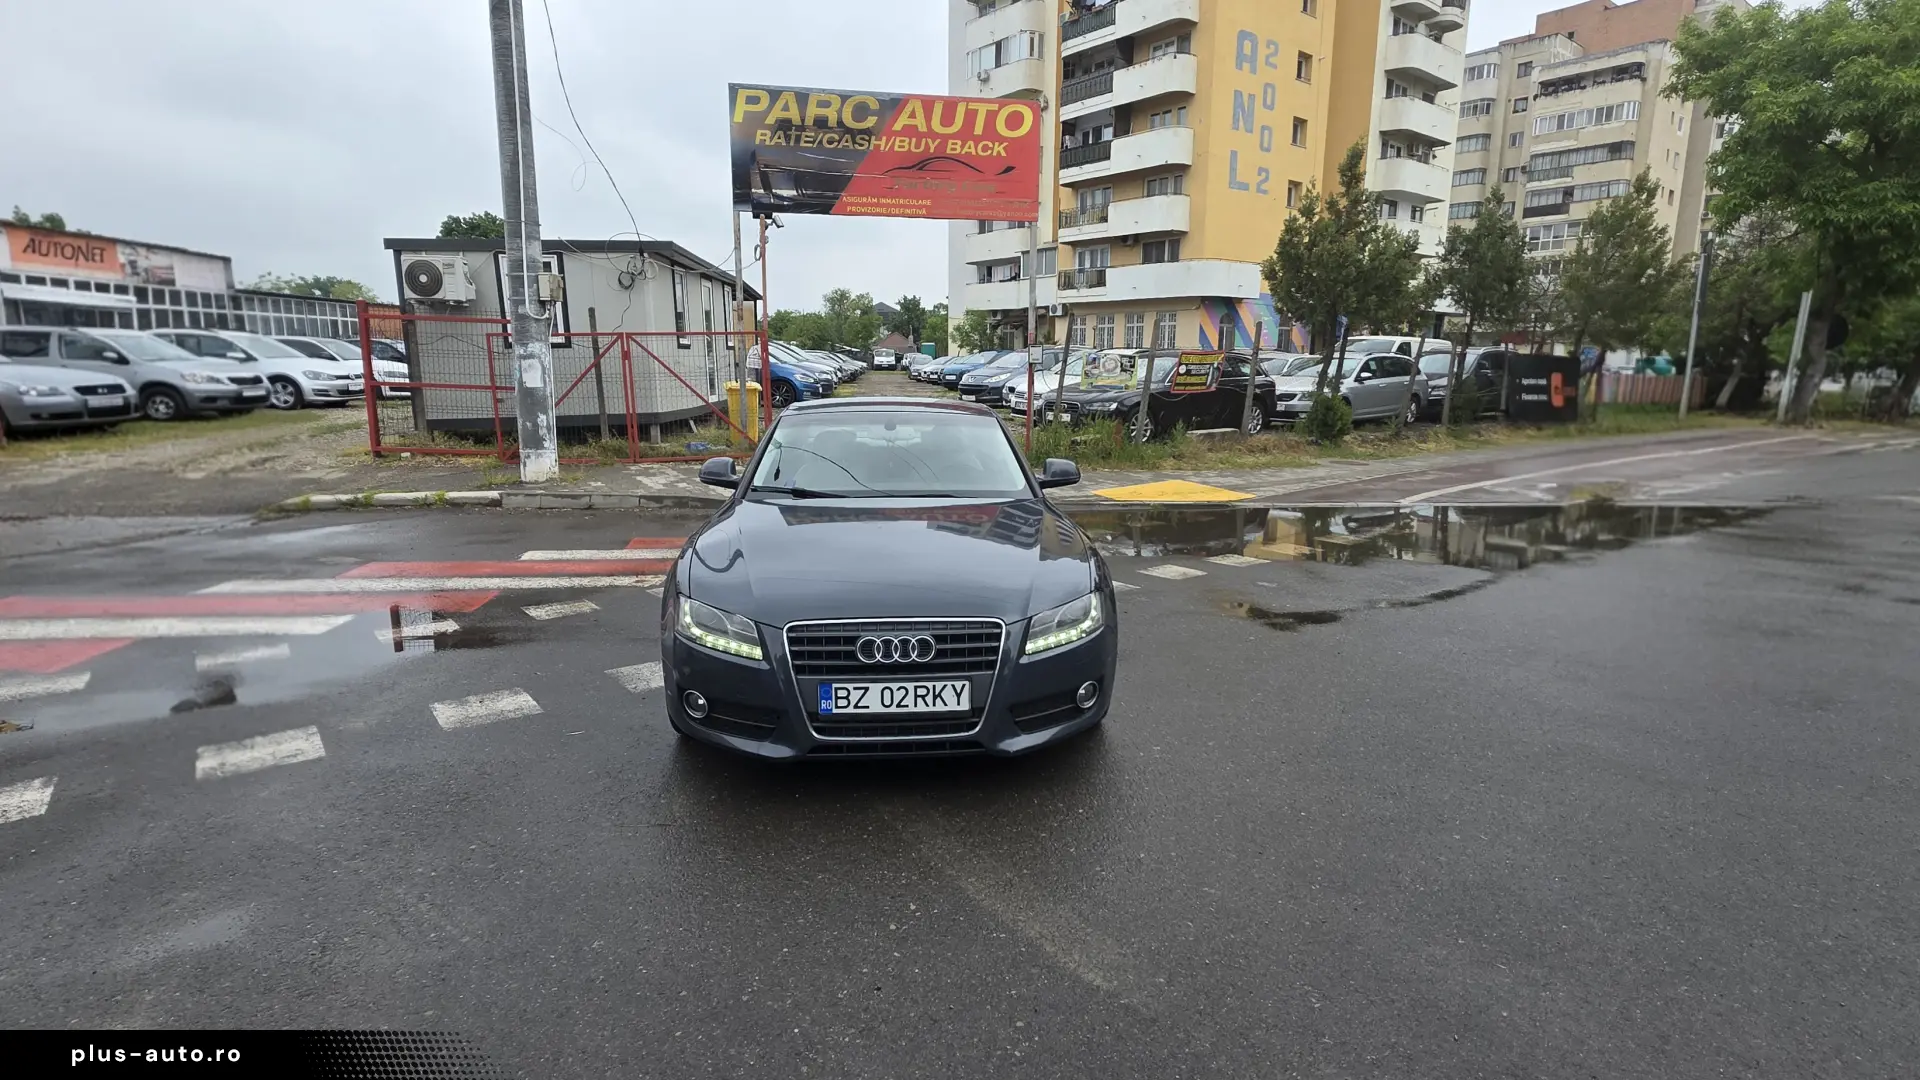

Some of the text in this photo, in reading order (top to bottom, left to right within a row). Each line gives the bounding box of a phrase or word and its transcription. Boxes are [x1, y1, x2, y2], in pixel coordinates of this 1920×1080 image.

[732, 88, 1034, 138] PARC AUTO
[755, 129, 1008, 157] RATE/CASH/BUY BACK
[22, 237, 106, 264] AUTONET
[820, 699, 832, 710] RO
[834, 686, 870, 710] BZ
